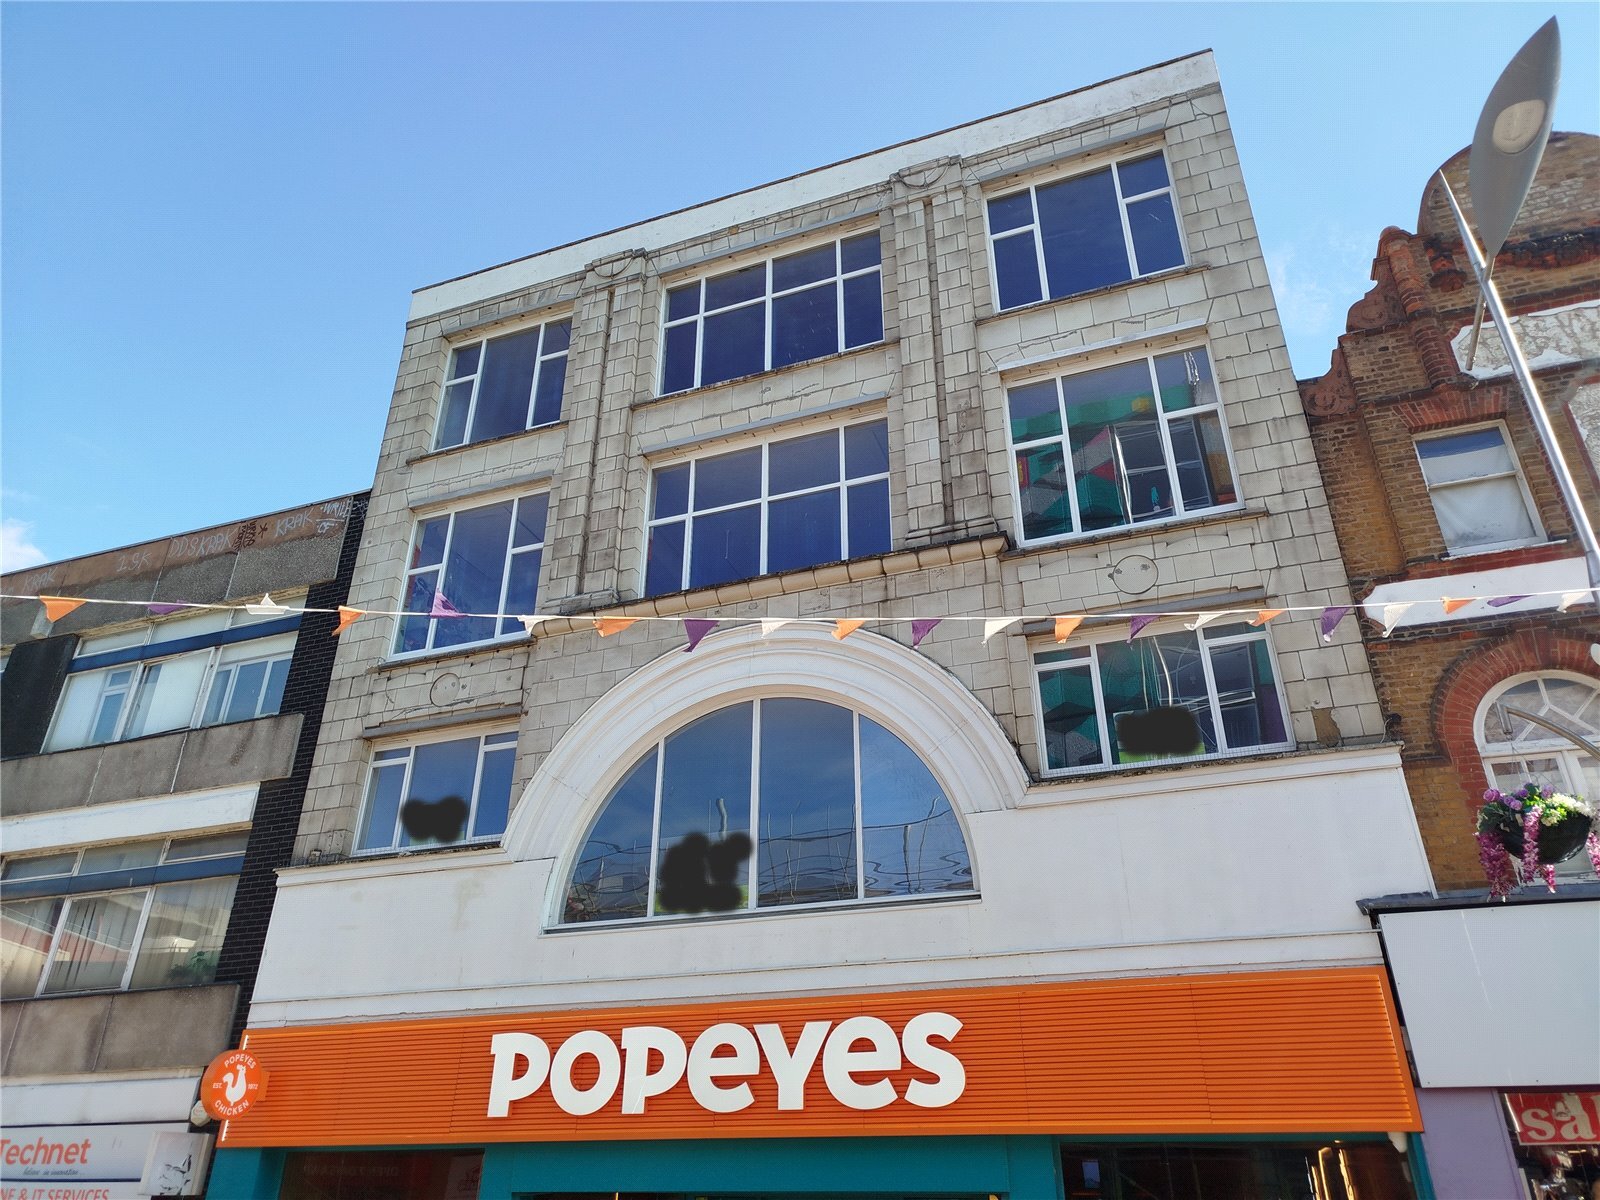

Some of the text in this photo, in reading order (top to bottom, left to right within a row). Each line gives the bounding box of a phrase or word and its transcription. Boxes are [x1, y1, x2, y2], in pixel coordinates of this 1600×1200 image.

[224, 1053, 256, 1069] POPEYES
[487, 1012, 966, 1118] POPEYES
[214, 1099, 249, 1116] CHICKEN
[47, 1188, 110, 1200] SERVICES
